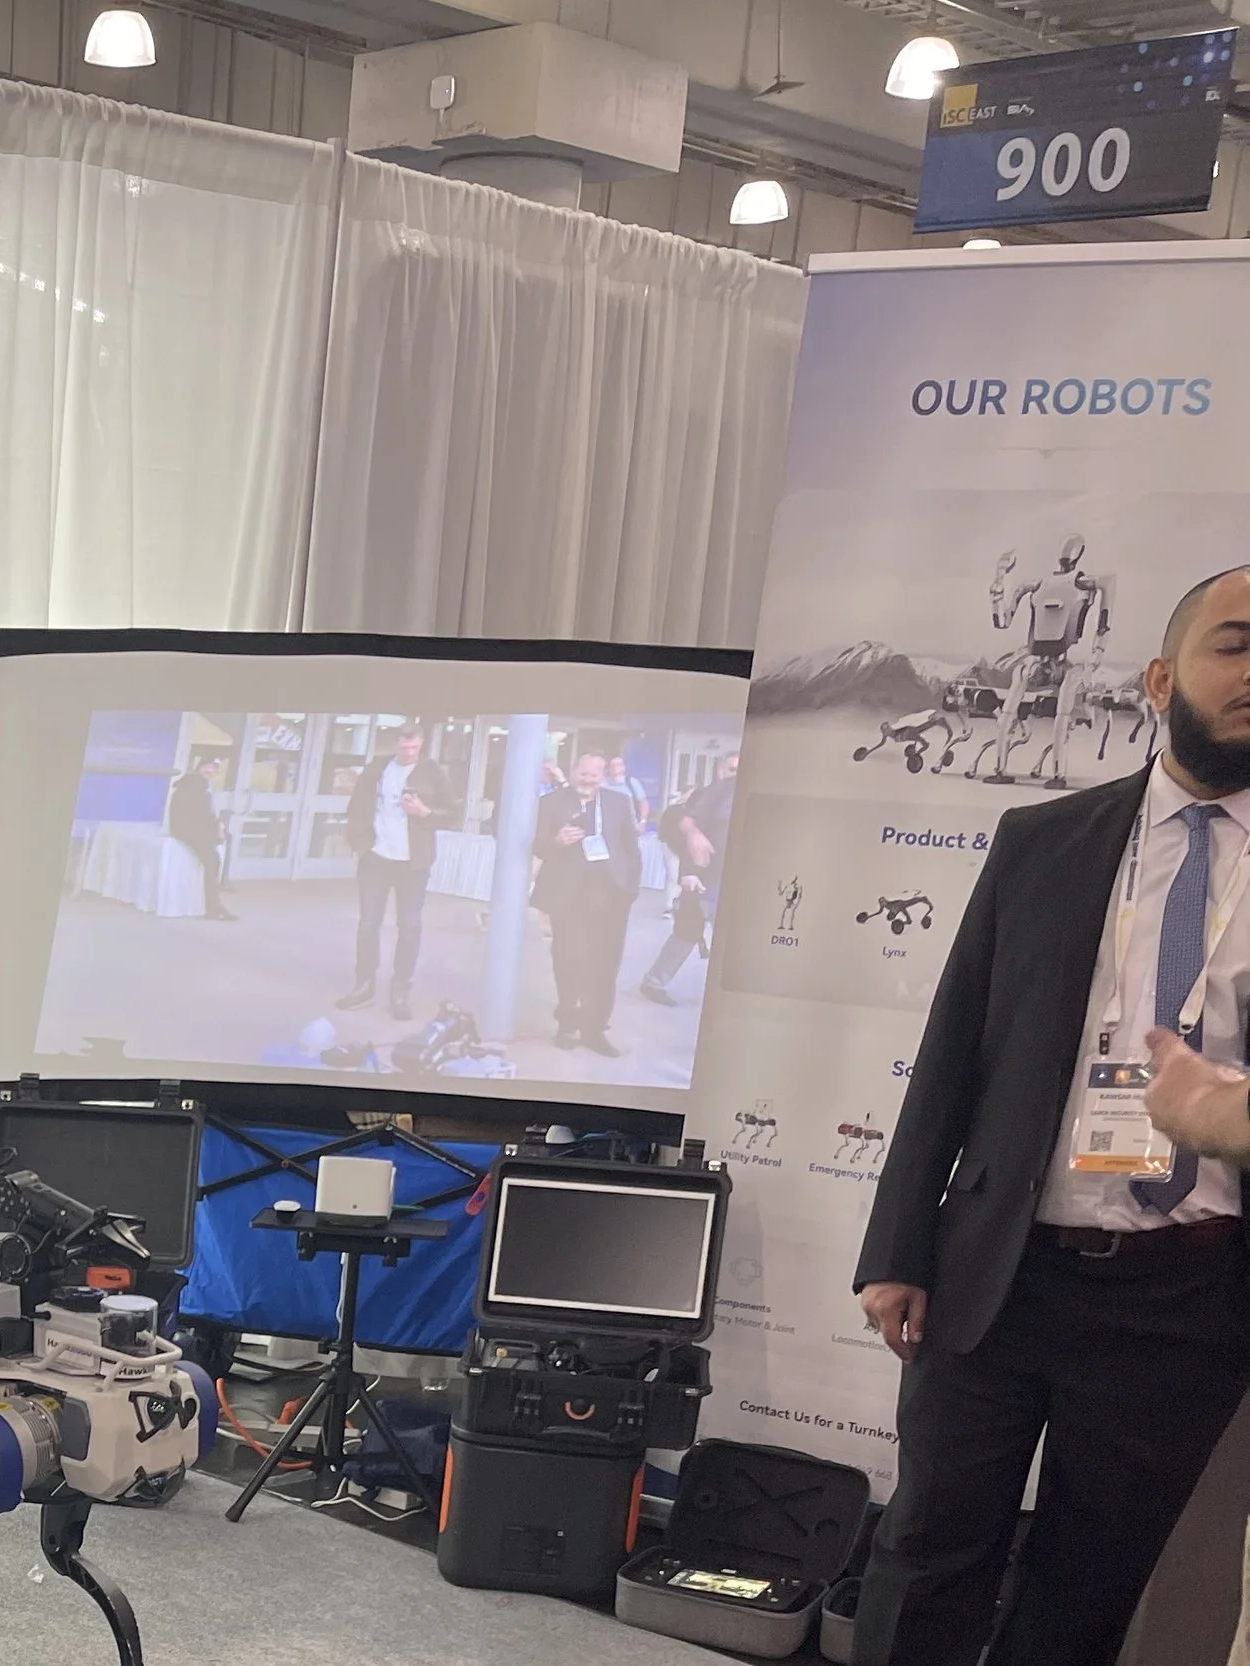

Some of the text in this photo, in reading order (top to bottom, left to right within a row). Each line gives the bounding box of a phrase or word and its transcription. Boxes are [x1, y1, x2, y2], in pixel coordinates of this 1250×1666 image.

[969, 105, 998, 120] EAST
[996, 127, 1131, 201] 900
[912, 377, 1213, 416] OUR ROBOTS
[881, 826, 966, 850] Product
[882, 946, 907, 959] Lynx
[721, 1150, 782, 1168] Utility Patrol
[809, 1163, 864, 1182] Emergency
[739, 1400, 899, 1445] Contact Us for a Turnkey
